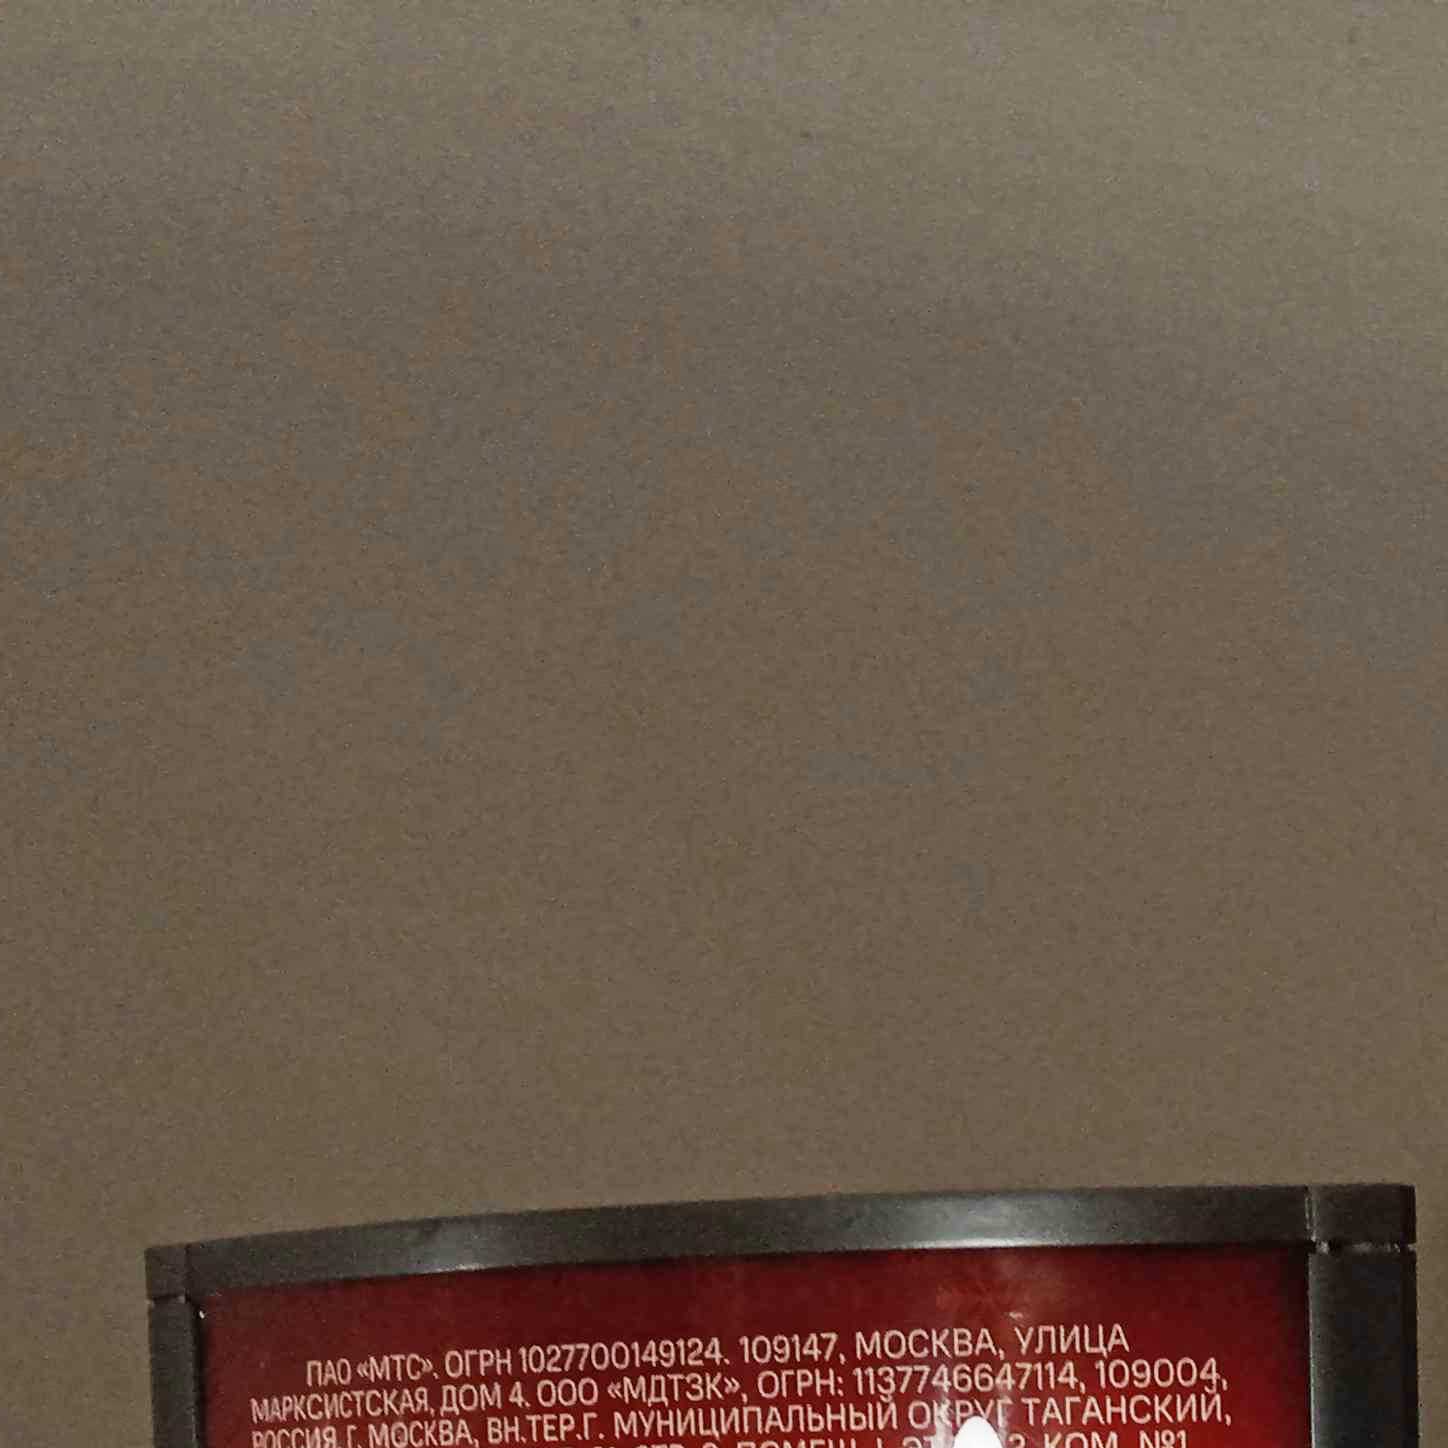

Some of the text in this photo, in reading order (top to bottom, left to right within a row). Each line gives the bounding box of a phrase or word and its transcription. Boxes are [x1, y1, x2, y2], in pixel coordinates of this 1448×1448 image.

[306, 1323, 1130, 1387] ПАО «МТС». ОГРН 1027700149124. 109147, МОСКВА, УЛИЦА
[251, 1388, 436, 1423] МАРКСИСТСКАЯ,
[440, 1382, 502, 1414] ДОМ
[509, 1382, 531, 1409] 4.
[536, 1377, 599, 1407] ООО
[757, 1367, 845, 1399] ОГРН:
[853, 1359, 1084, 1396] 1137746647114,
[1095, 1357, 1229, 1392] 109004,
[487, 1410, 605, 1444] ВН.ТЕР.Г.
[613, 1392, 898, 1440] МУНИЦИПАЛЬНЫЙ
[908, 1396, 1013, 1426] ОКРУГ
[1021, 1384, 1233, 1427] ТАГАНСКИЙ,
